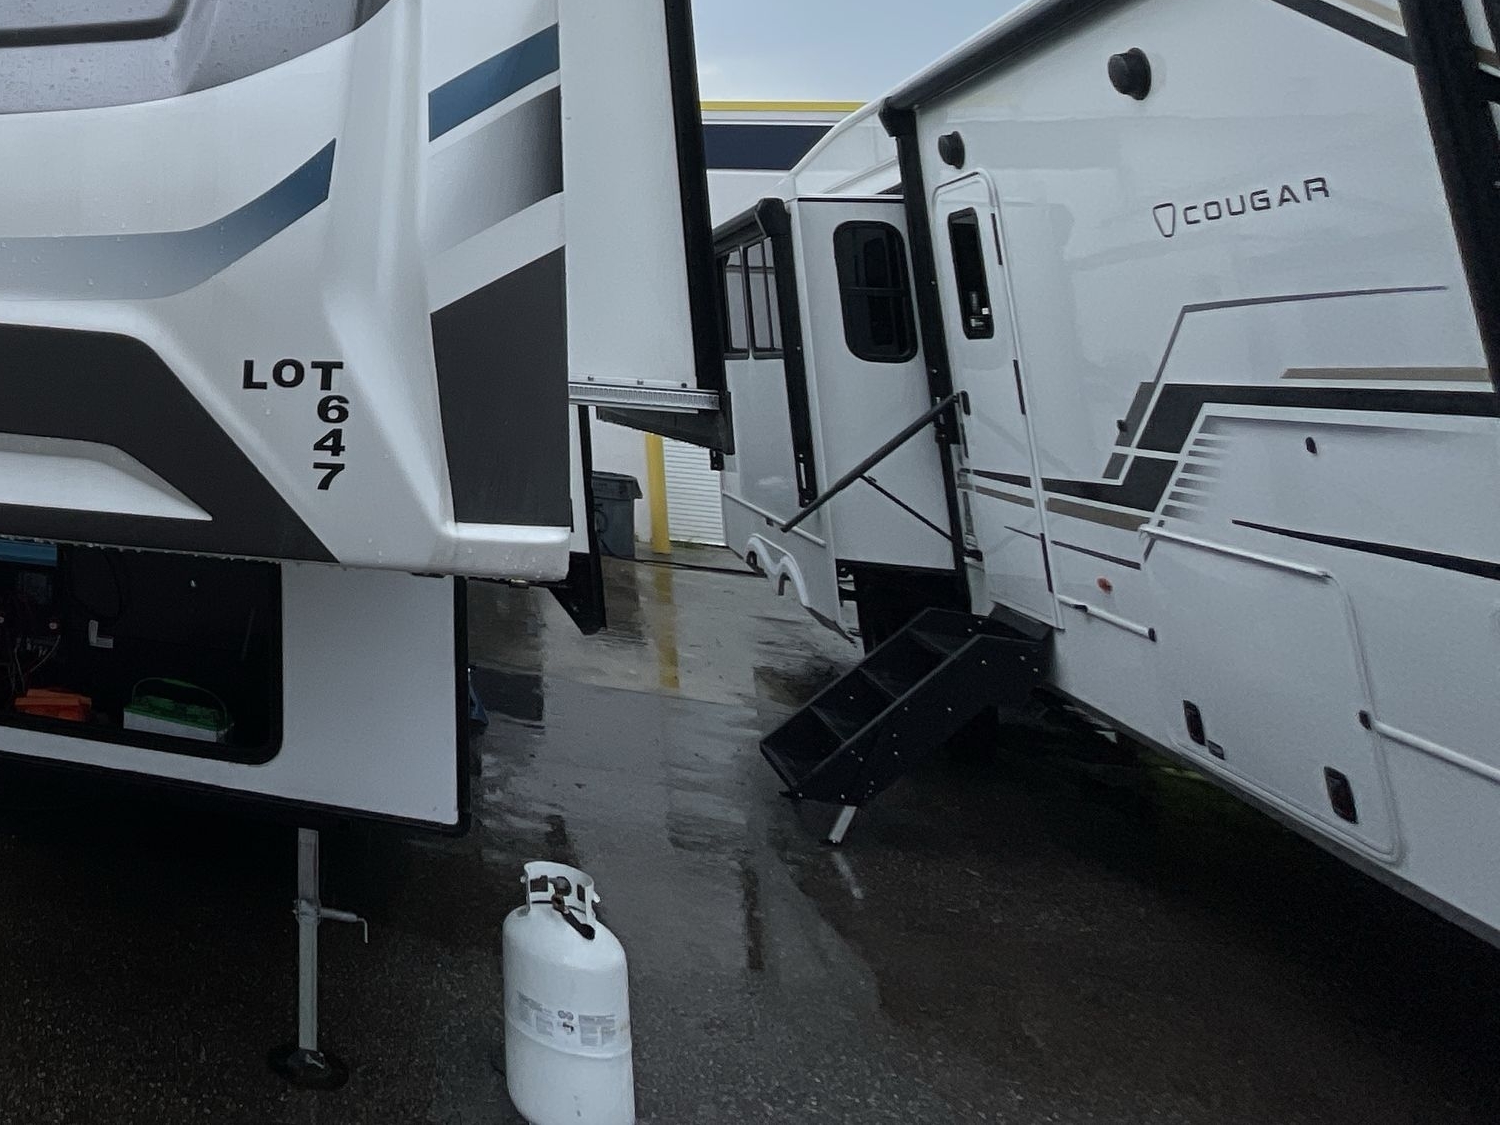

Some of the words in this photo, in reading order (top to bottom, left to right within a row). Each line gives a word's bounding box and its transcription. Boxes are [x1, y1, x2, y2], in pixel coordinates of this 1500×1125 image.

[1182, 176, 1330, 225] COUGAR
[242, 359, 344, 391] LOT
[313, 394, 350, 491] 647
